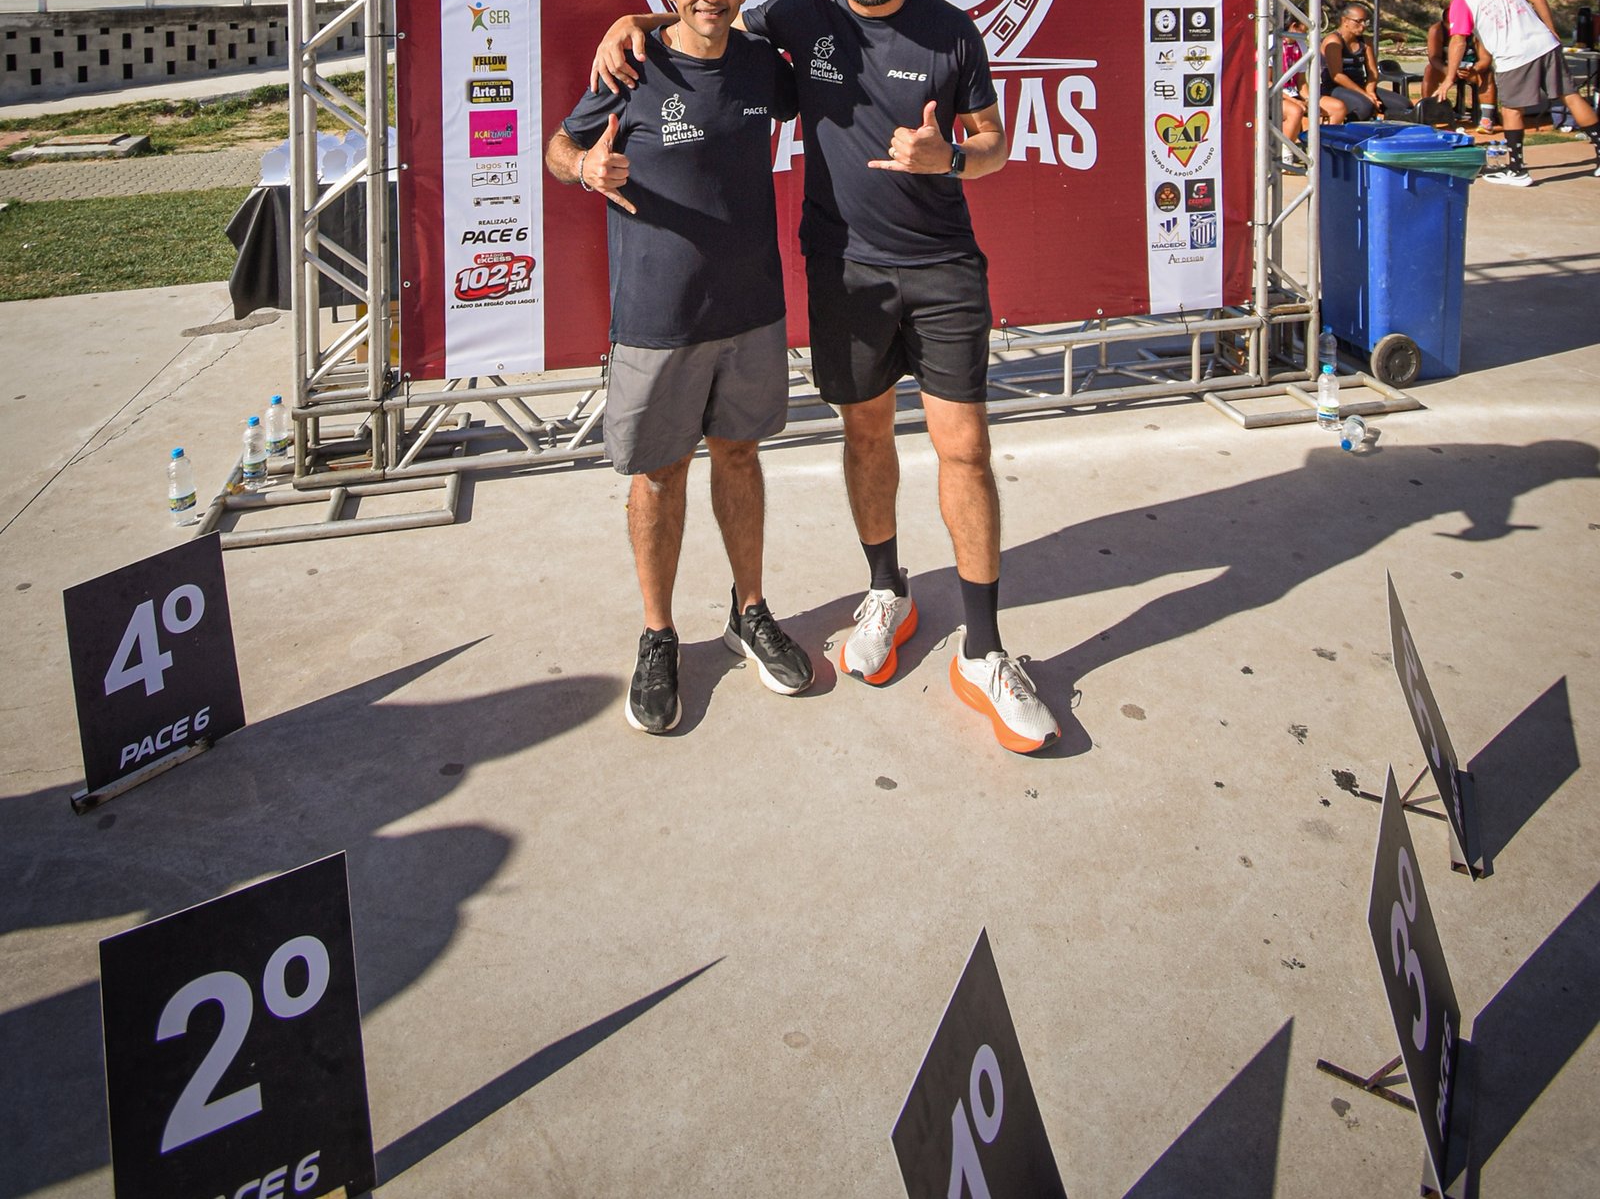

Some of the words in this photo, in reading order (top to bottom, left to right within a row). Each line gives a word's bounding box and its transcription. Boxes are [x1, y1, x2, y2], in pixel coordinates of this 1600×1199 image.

[489, 10, 510, 24] SER
[473, 55, 508, 66] YELLOW
[810, 59, 832, 70] Onda
[475, 65, 490, 73] BOX
[810, 67, 844, 81] Inclusão
[887, 69, 918, 81] PACE
[918, 73, 928, 81] 6
[472, 87, 496, 97] Arte
[500, 85, 511, 97] in
[743, 107, 763, 116] PACE
[662, 121, 688, 133] Onda
[662, 128, 704, 143] Inclusão
[476, 162, 502, 170] Lagos
[505, 161, 517, 169] Tri
[478, 217, 518, 225] REALIZAÇÃO
[462, 228, 514, 245] PACE
[516, 227, 528, 241] 6
[1152, 241, 1187, 249] MACEDO
[508, 279, 528, 292] FM
[119, 715, 190, 770] PACE
[193, 705, 211, 731] 6
[294, 1150, 321, 1192] 6
